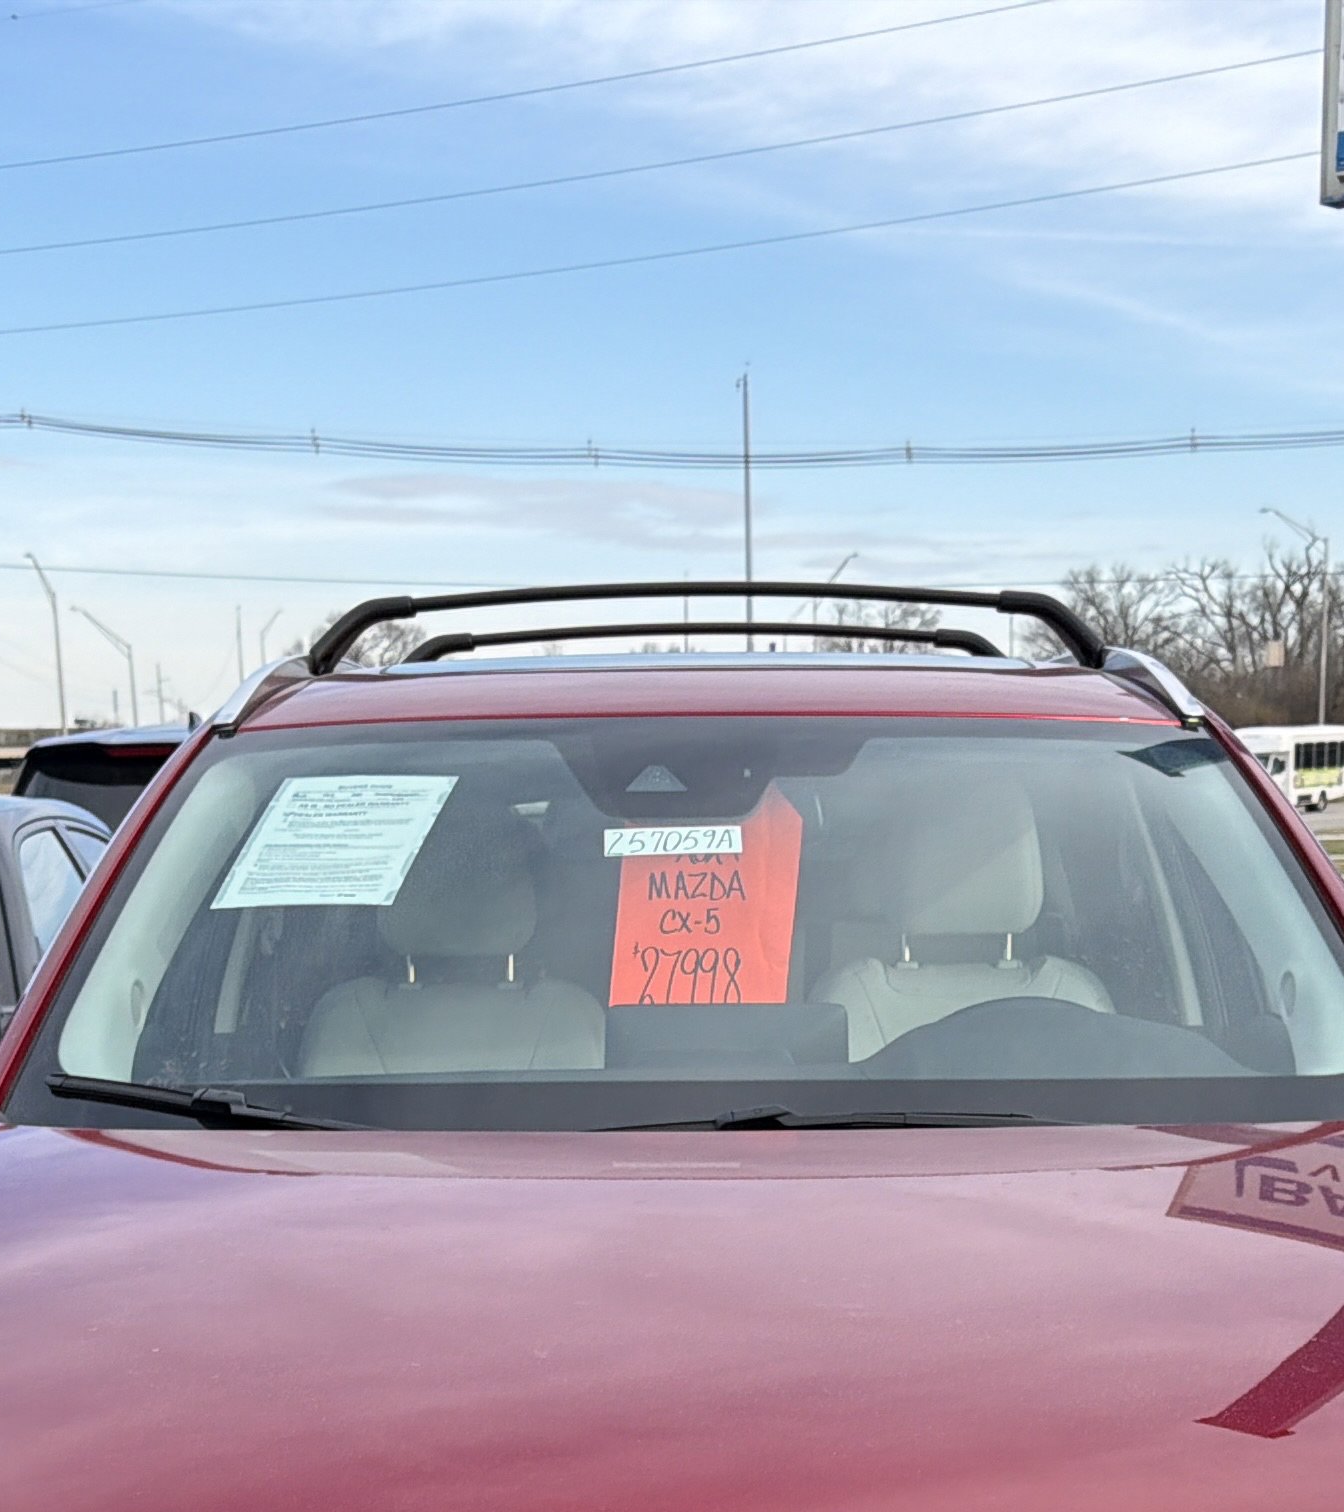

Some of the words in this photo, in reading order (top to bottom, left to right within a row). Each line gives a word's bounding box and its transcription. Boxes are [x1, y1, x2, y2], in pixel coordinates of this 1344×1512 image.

[606, 828, 736, 856] 257059A
[648, 870, 746, 901] MAZDA
[659, 907, 721, 935] CX-5
